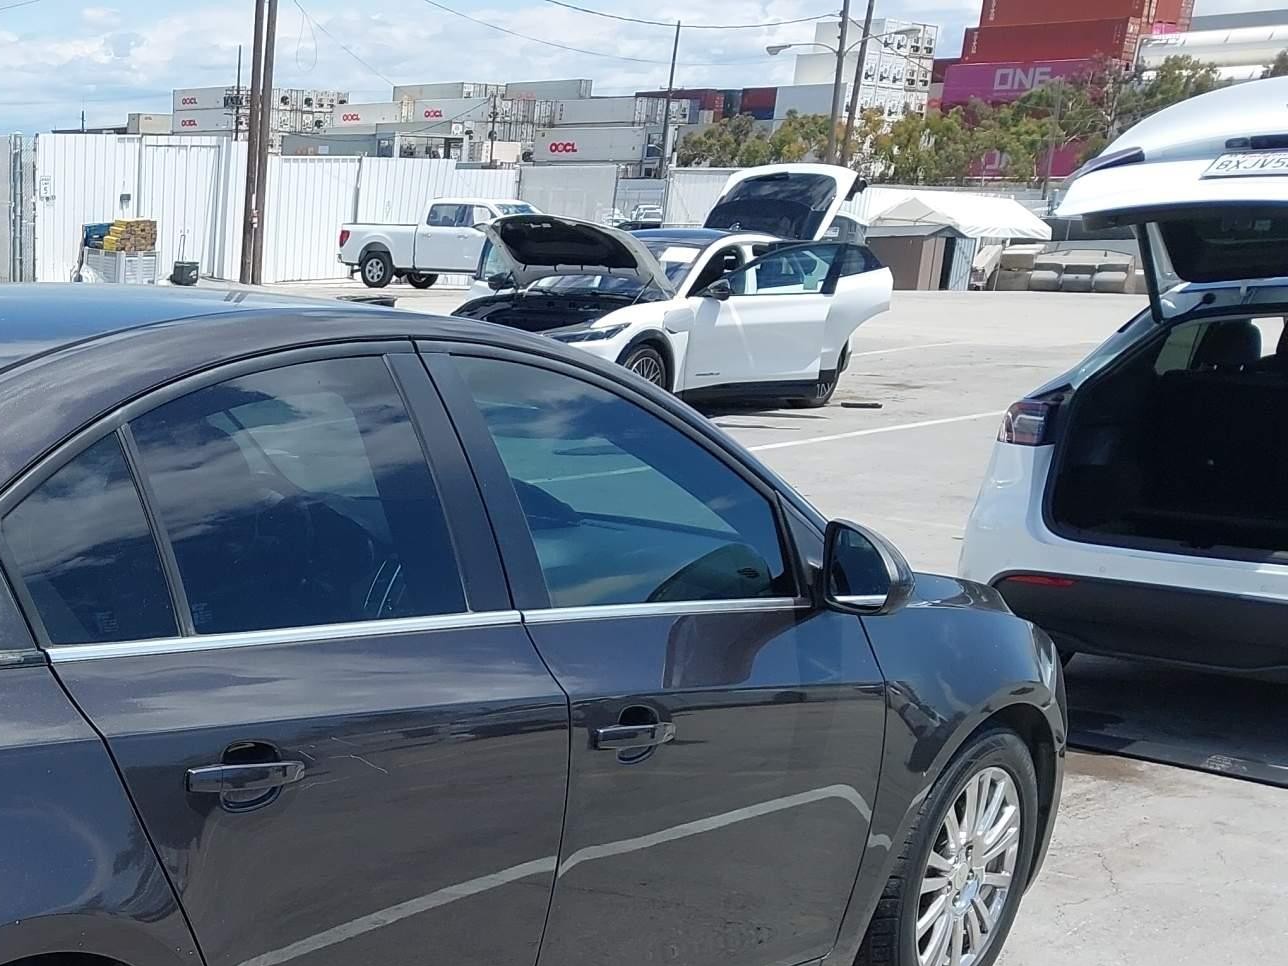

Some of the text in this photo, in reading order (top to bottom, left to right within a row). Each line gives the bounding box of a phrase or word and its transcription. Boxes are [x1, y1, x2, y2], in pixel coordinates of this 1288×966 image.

[993, 67, 1051, 90] ONE
[341, 113, 360, 122] OOCL
[424, 109, 443, 118] OOCL
[549, 142, 577, 153] OOCL
